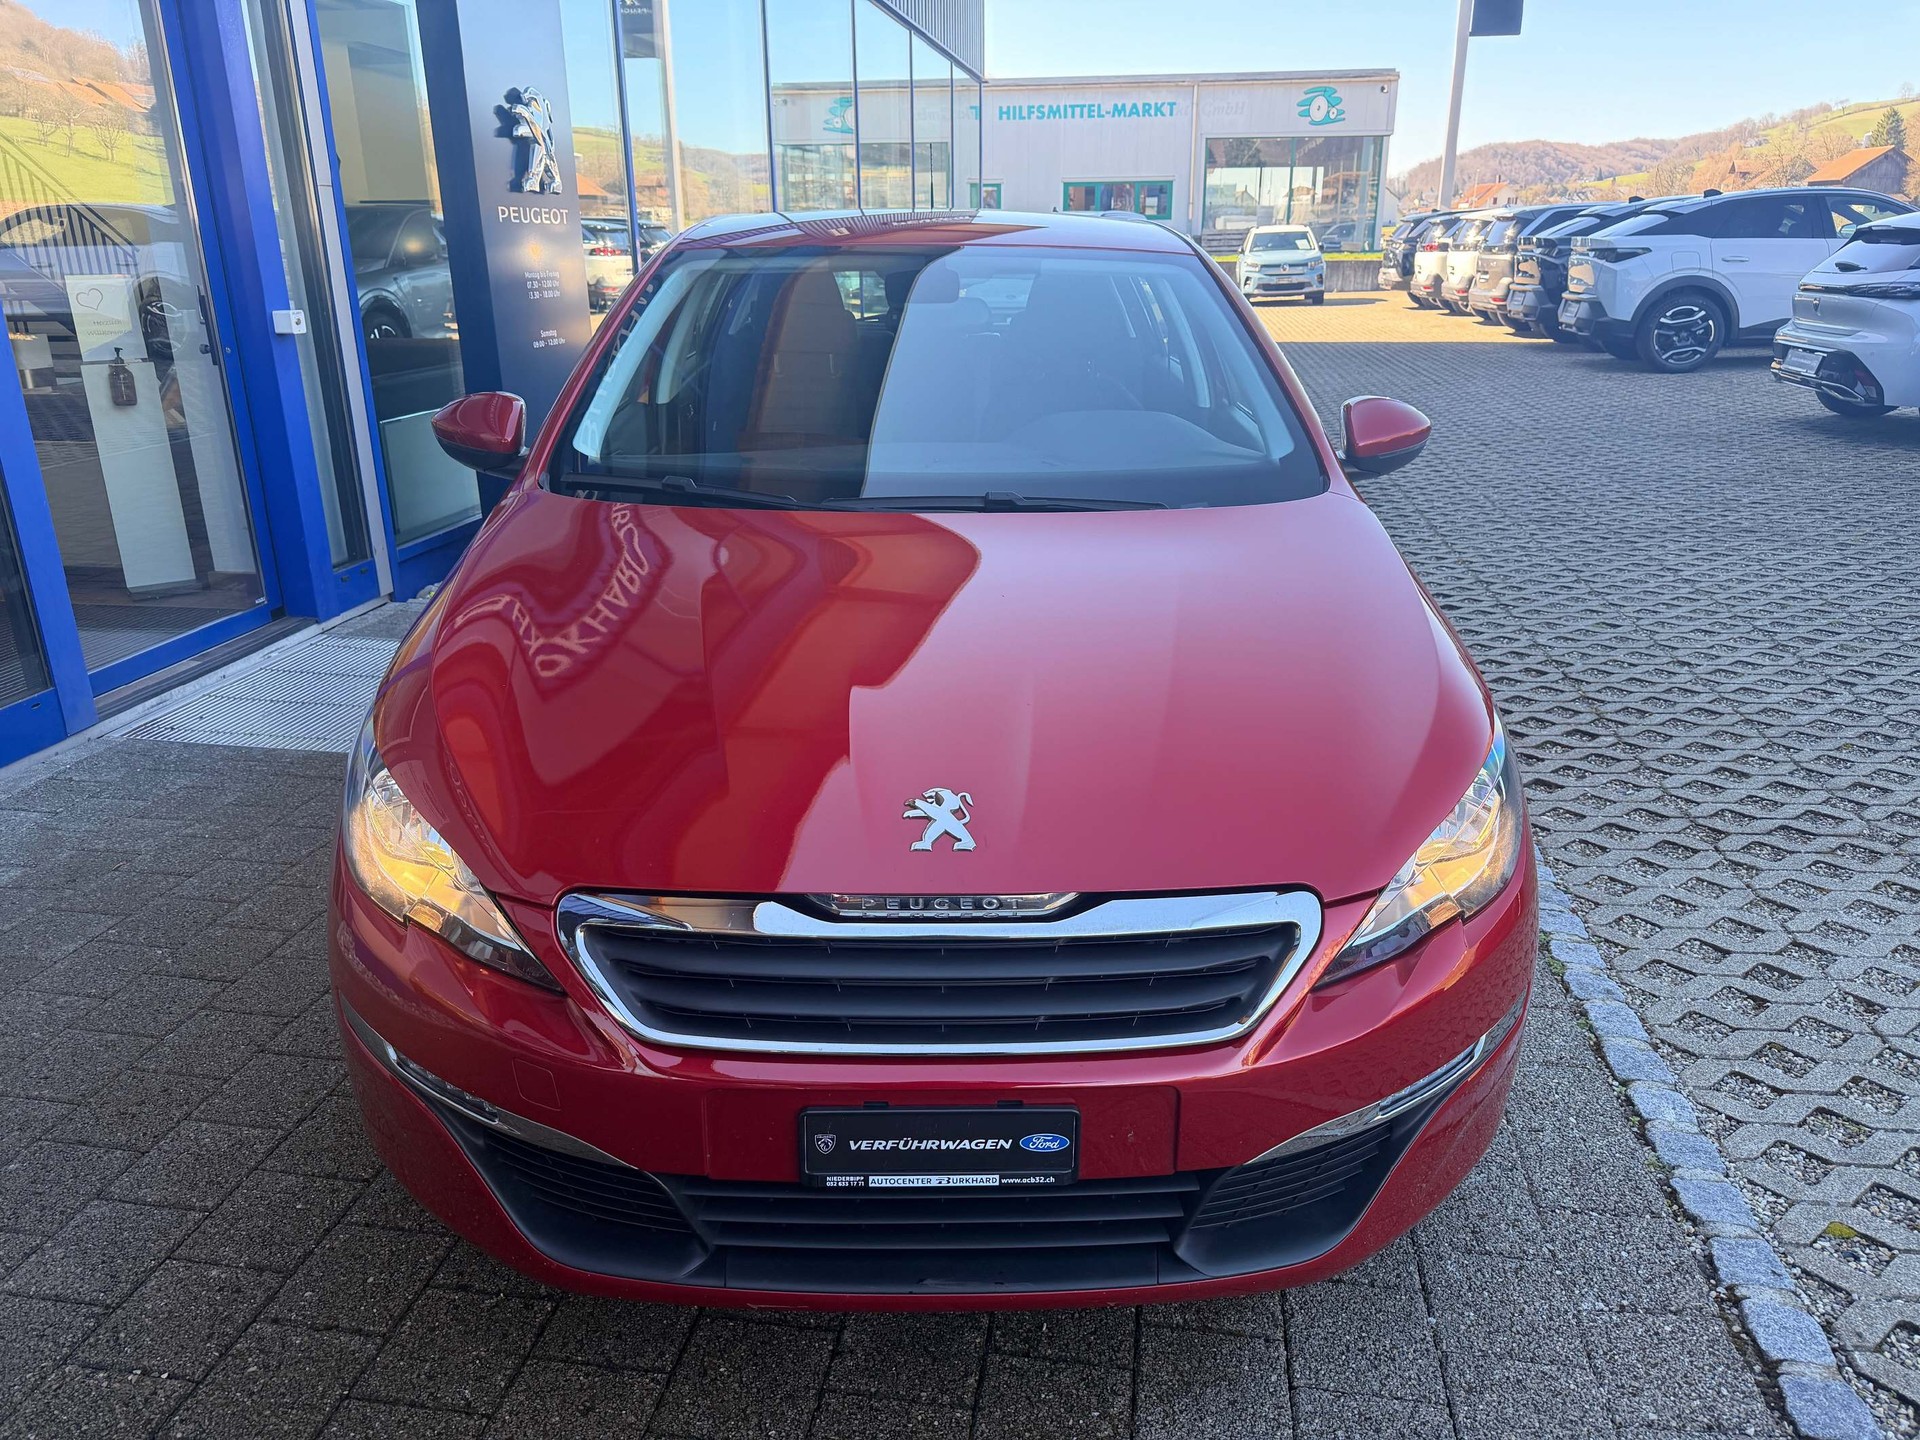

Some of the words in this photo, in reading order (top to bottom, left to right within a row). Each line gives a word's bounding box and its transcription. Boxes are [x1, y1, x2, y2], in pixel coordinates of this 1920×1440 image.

[998, 102, 1177, 120] HILFSMITTEL-MARKT
[498, 206, 568, 225] PEUGEOT
[861, 898, 1024, 910] PEUGEOT
[849, 1138, 1013, 1151] VERFÜHRWAGEN
[1028, 1135, 1060, 1149] Ford
[870, 1177, 932, 1185] AUTOCENTER
[936, 1176, 998, 1185] BURKHARD
